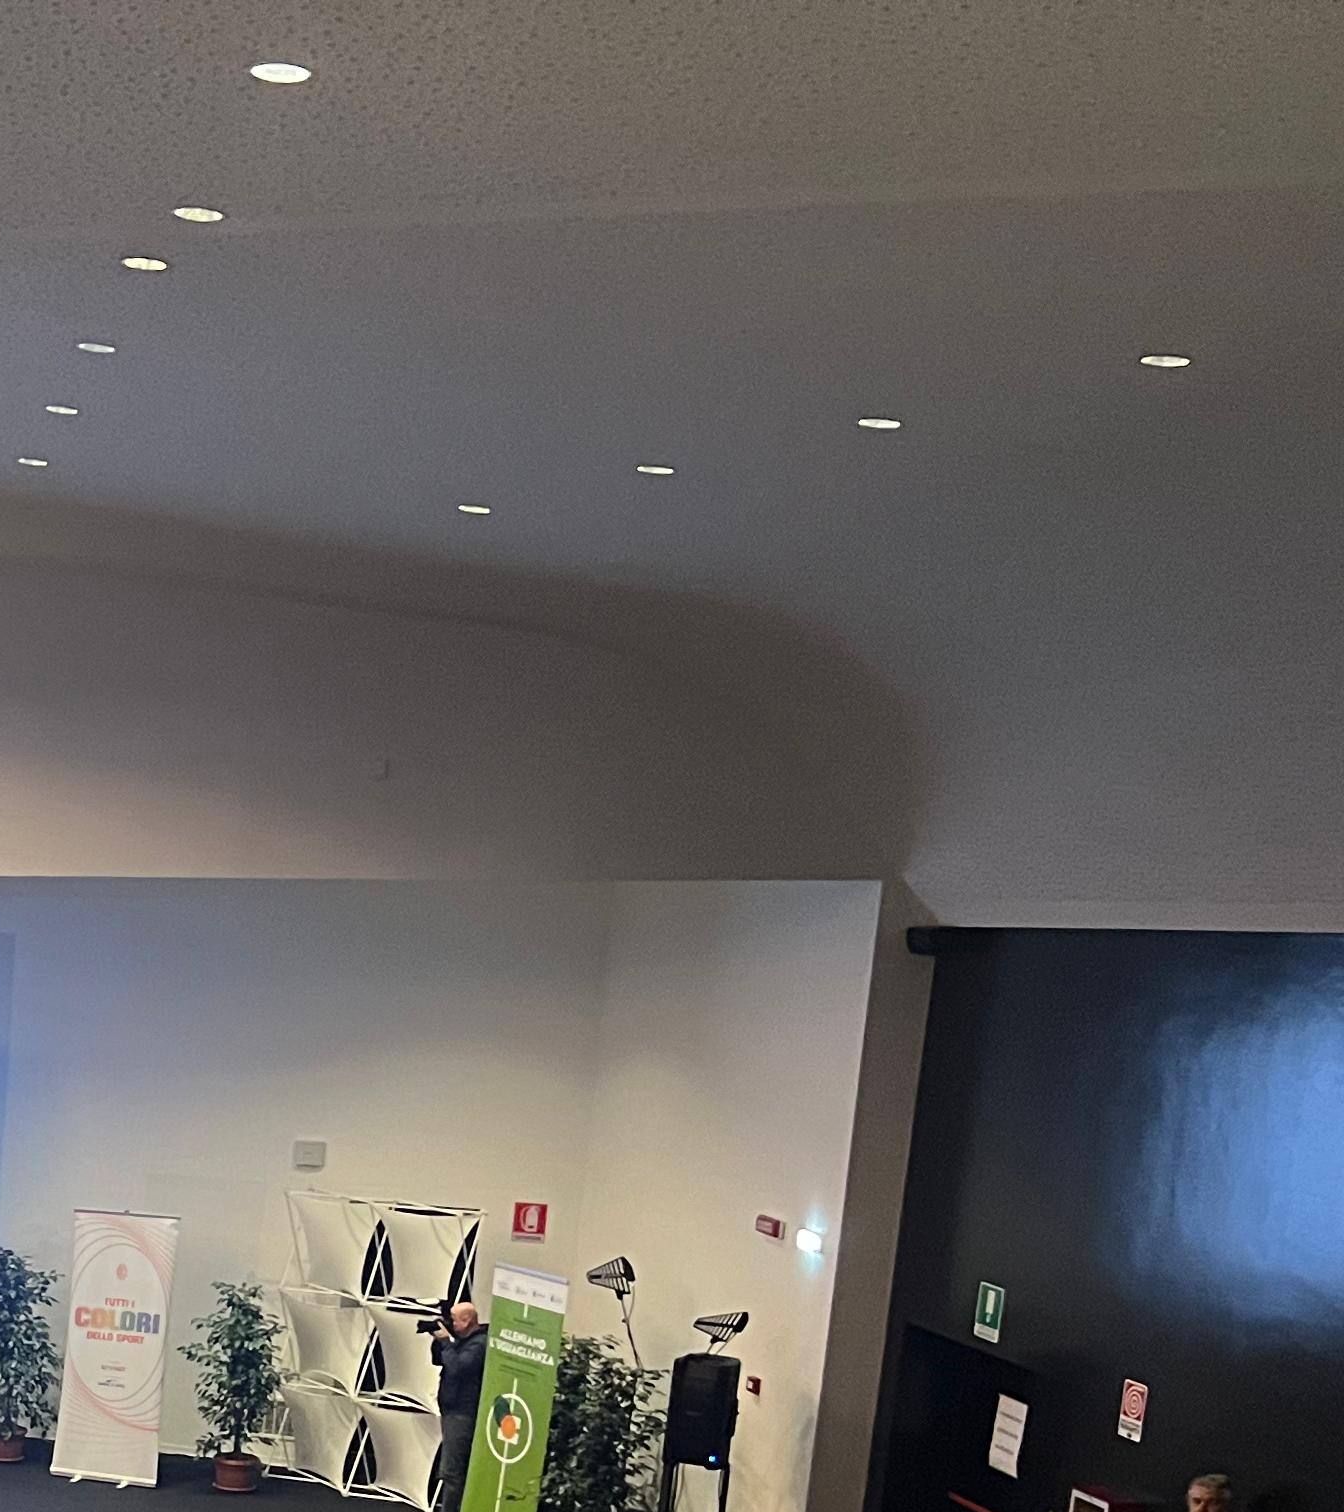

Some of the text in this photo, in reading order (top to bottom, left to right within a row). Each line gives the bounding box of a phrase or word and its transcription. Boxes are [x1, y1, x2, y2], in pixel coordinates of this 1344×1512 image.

[105, 1297, 129, 1308] TUTTI
[74, 1305, 161, 1335] COLORI
[86, 1330, 145, 1345] DELLO SPORT
